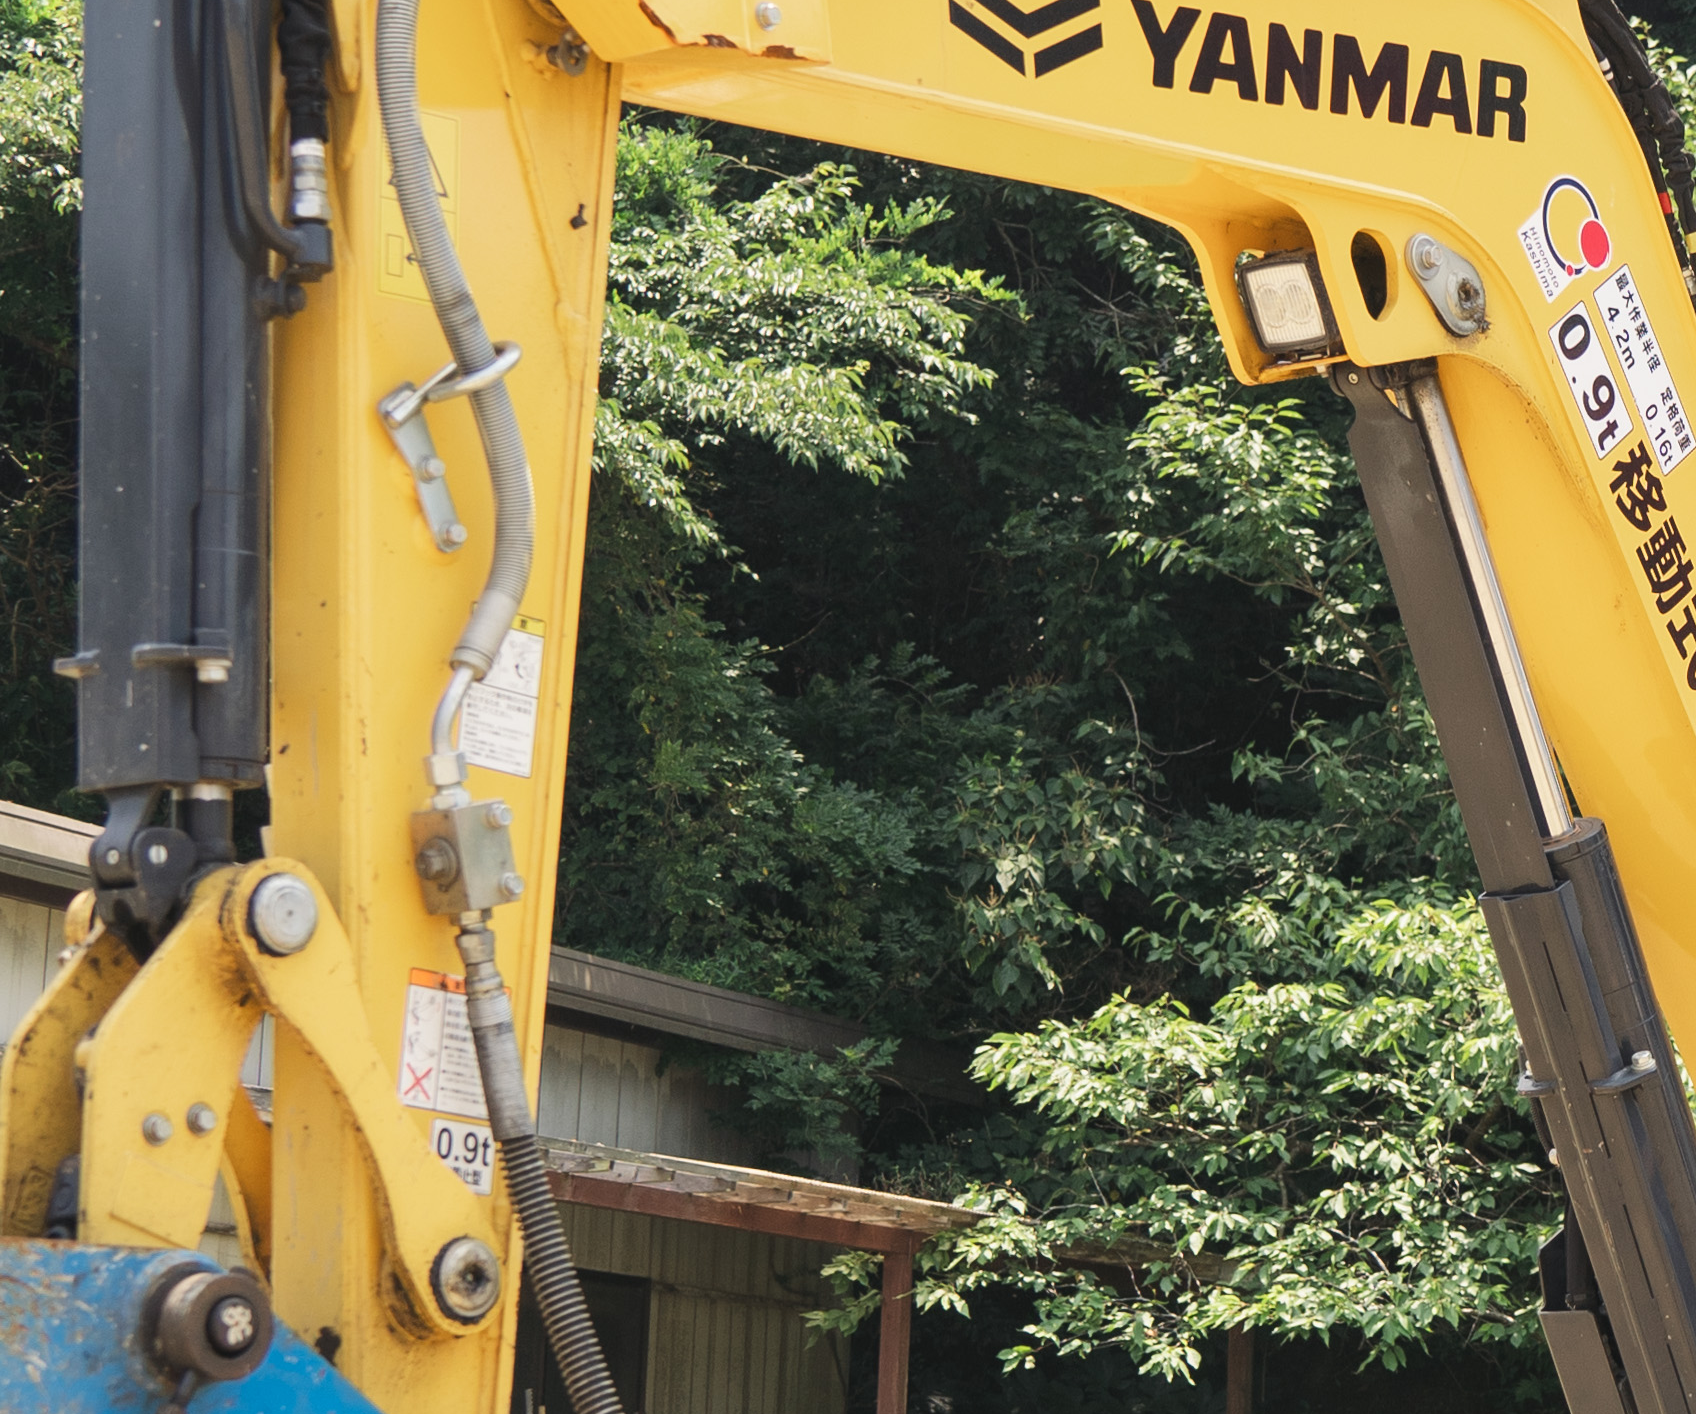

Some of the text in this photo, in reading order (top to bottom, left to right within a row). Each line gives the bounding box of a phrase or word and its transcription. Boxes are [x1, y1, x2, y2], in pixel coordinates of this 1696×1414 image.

[1520, 230, 1554, 298] Kashima
[1529, 226, 1560, 289] Hinomoto
[1558, 313, 1619, 452] 0.9t
[1614, 272, 1693, 454] 最大作業半径 定格荷重
[437, 1128, 491, 1167] 0.9t
